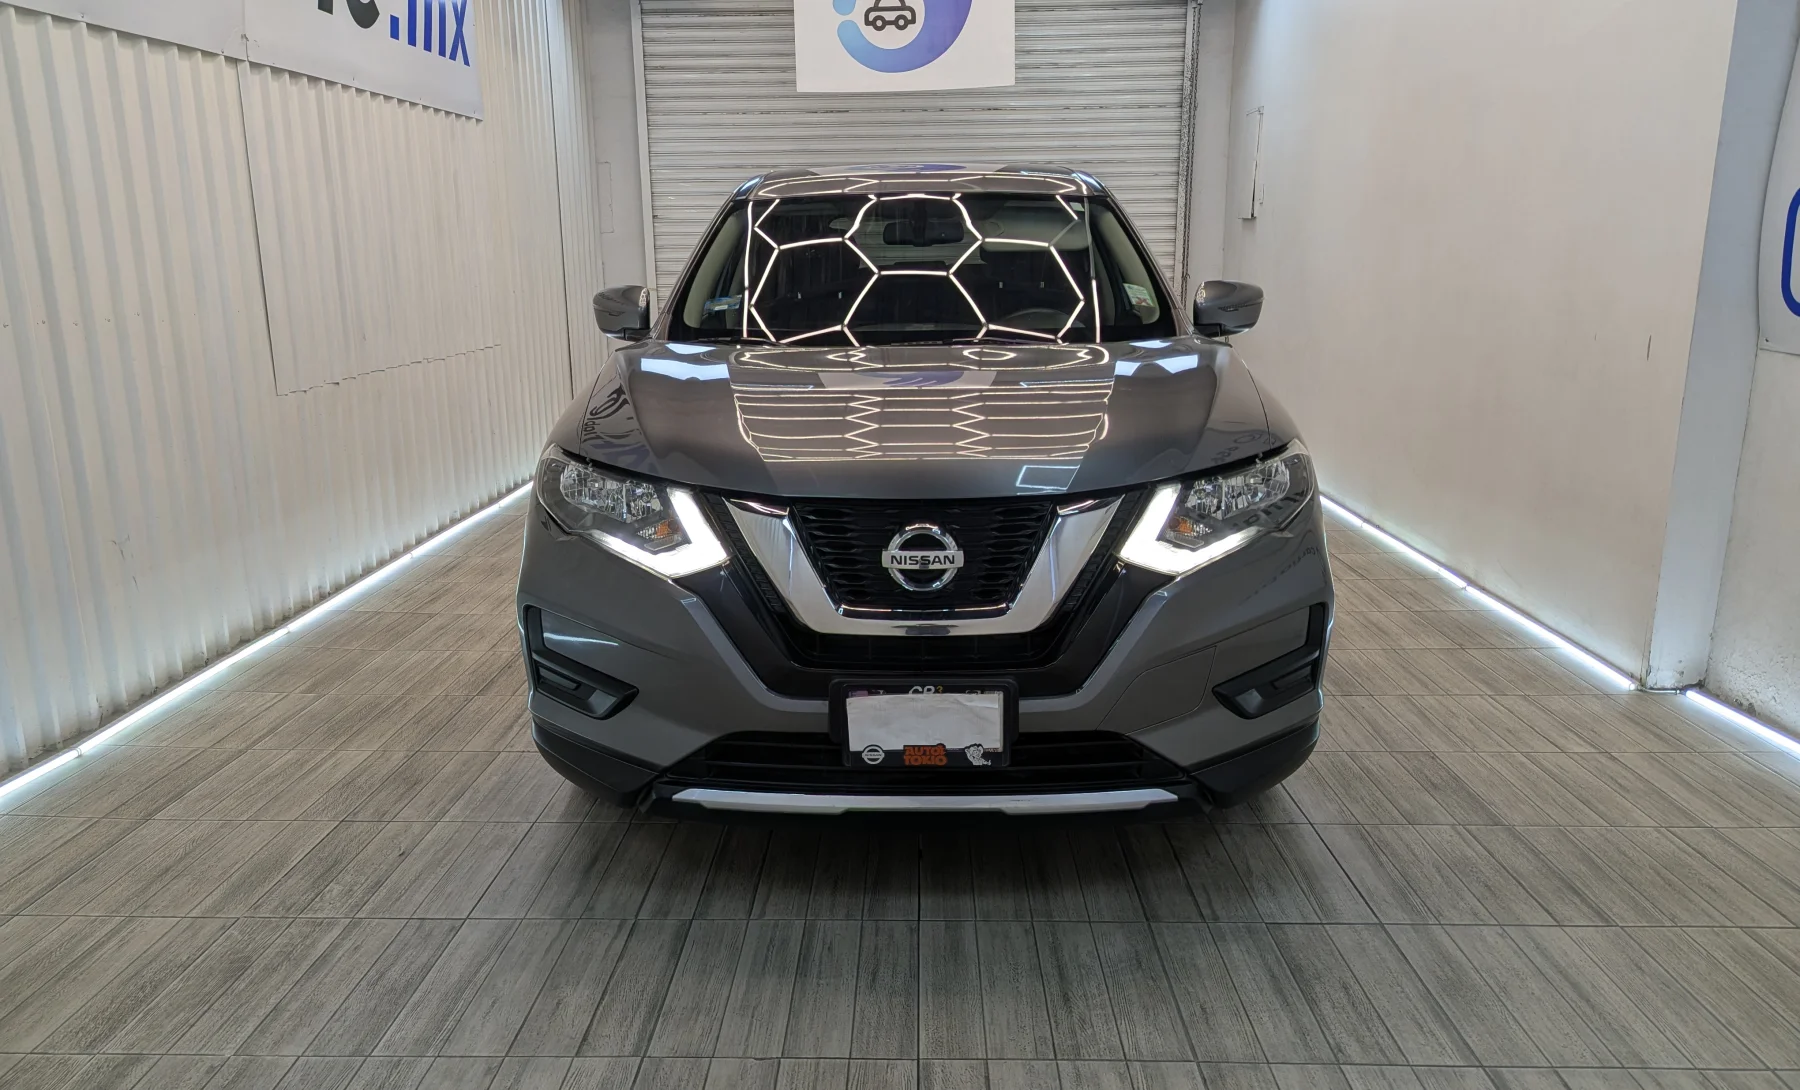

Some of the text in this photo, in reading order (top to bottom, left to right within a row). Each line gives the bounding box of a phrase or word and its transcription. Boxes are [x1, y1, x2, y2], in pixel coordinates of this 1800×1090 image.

[890, 555, 955, 566] NISSAN
[904, 746, 941, 756] AUTO
[903, 755, 948, 766] TOKIO
